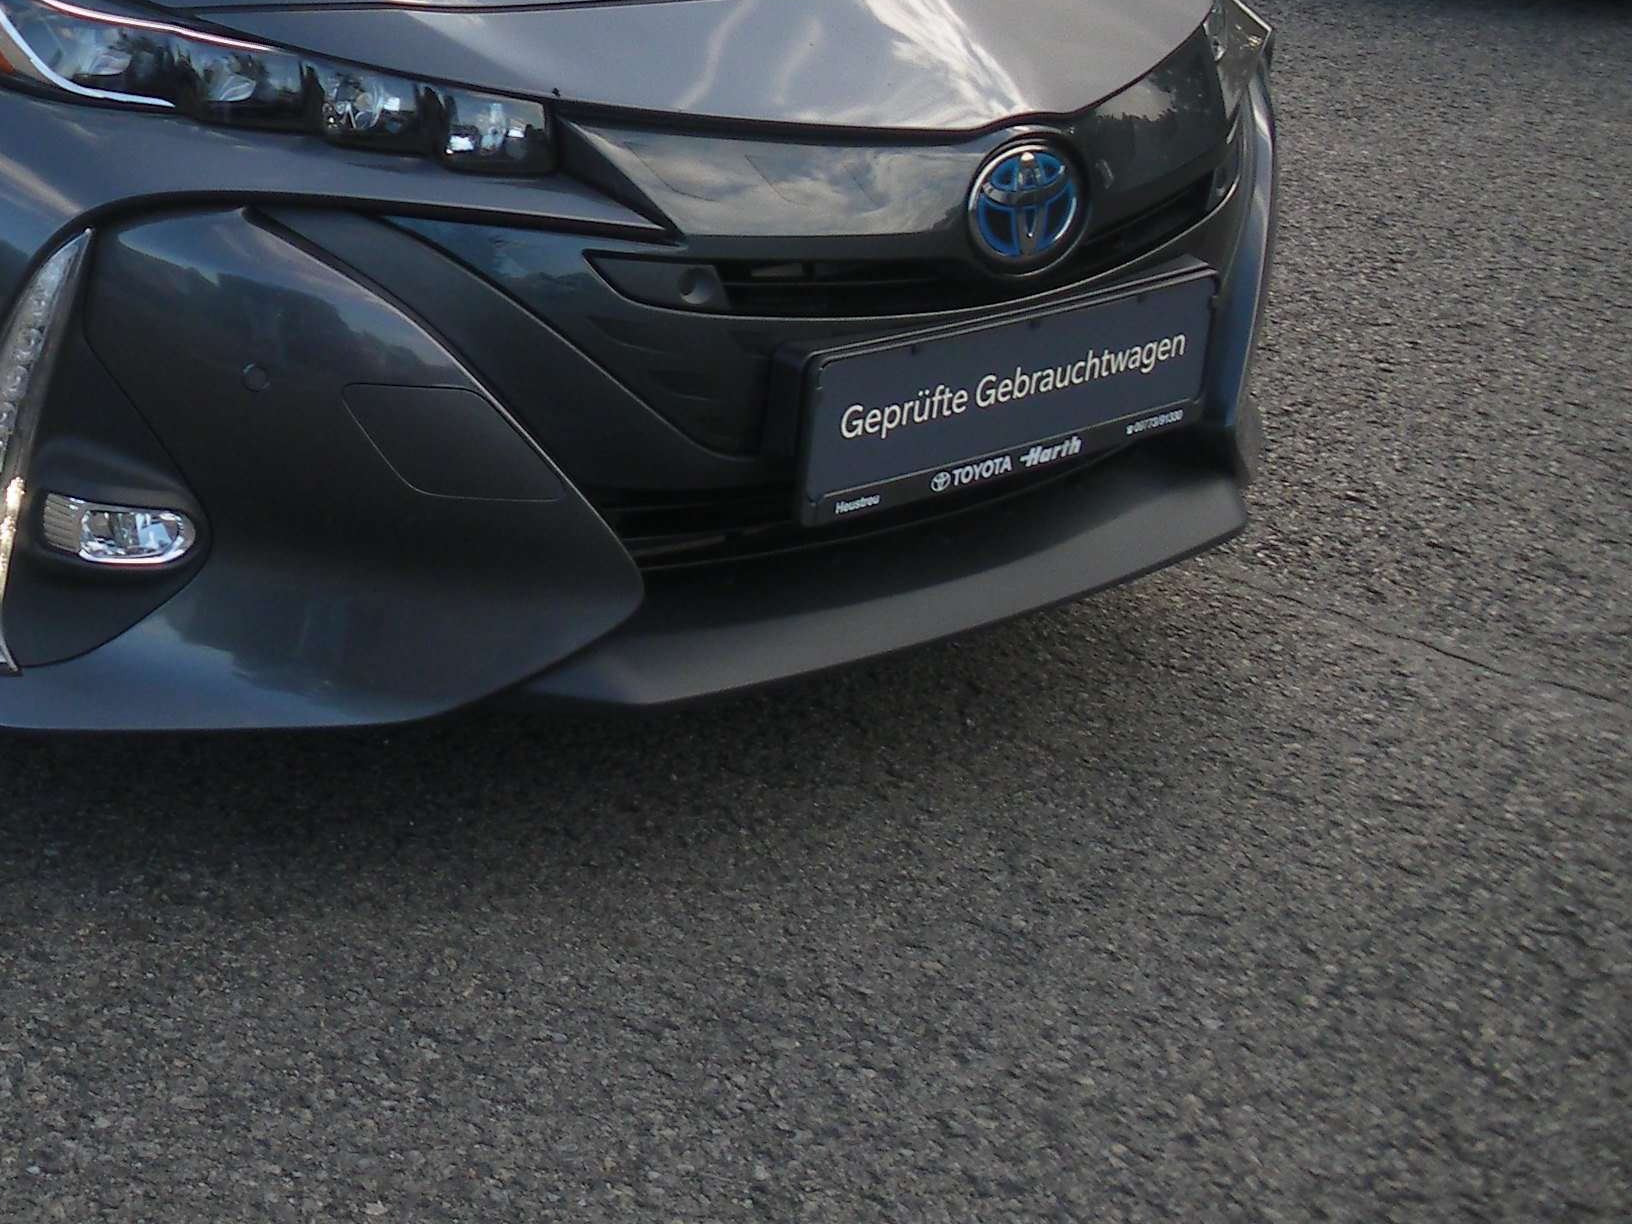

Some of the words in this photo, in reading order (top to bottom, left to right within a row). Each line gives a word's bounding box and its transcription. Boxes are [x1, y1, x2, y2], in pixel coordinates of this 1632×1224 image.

[840, 384, 968, 439] Geprüfte
[975, 333, 1186, 408] Gebrauchtwagen
[951, 456, 1013, 486] TOYOTA
[1020, 435, 1082, 467] Harth
